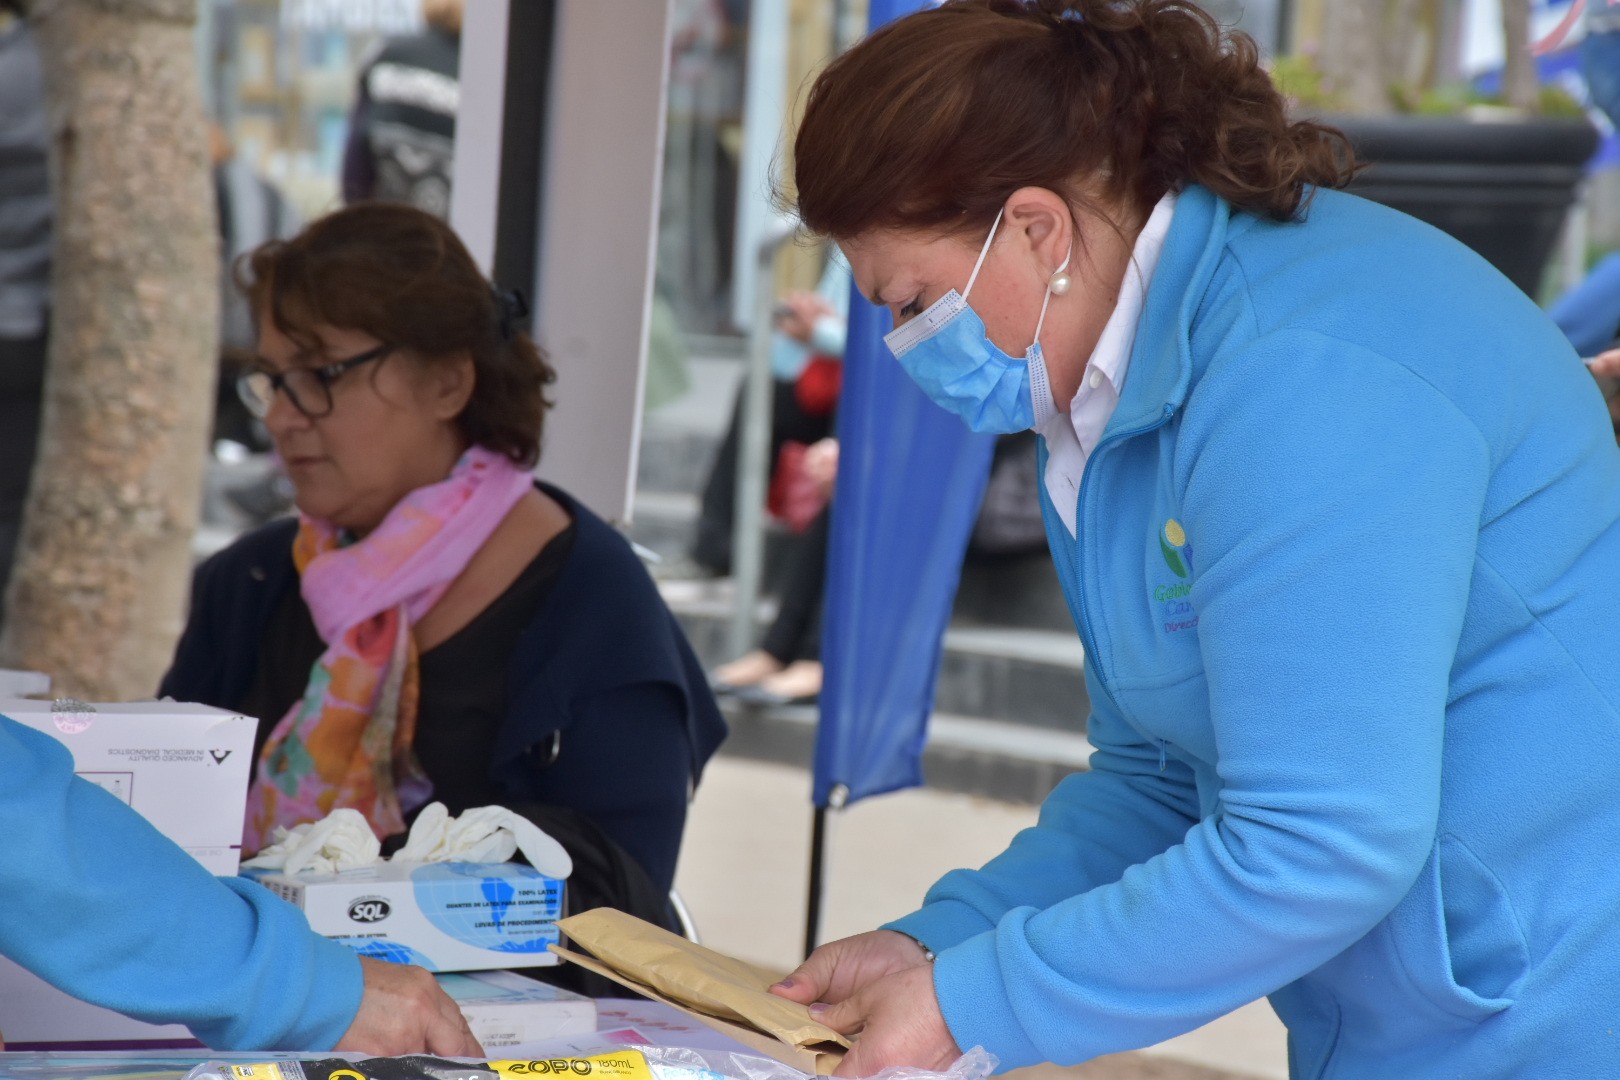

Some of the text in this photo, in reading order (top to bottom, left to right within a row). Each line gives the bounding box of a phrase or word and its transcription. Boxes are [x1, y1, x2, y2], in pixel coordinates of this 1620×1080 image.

[1154, 581, 1192, 603] Gobie
[107, 748, 160, 756] DIAGNOSTICS
[537, 888, 557, 896] LATEX
[352, 903, 386, 921] SQL
[508, 1059, 592, 1076] COPO
